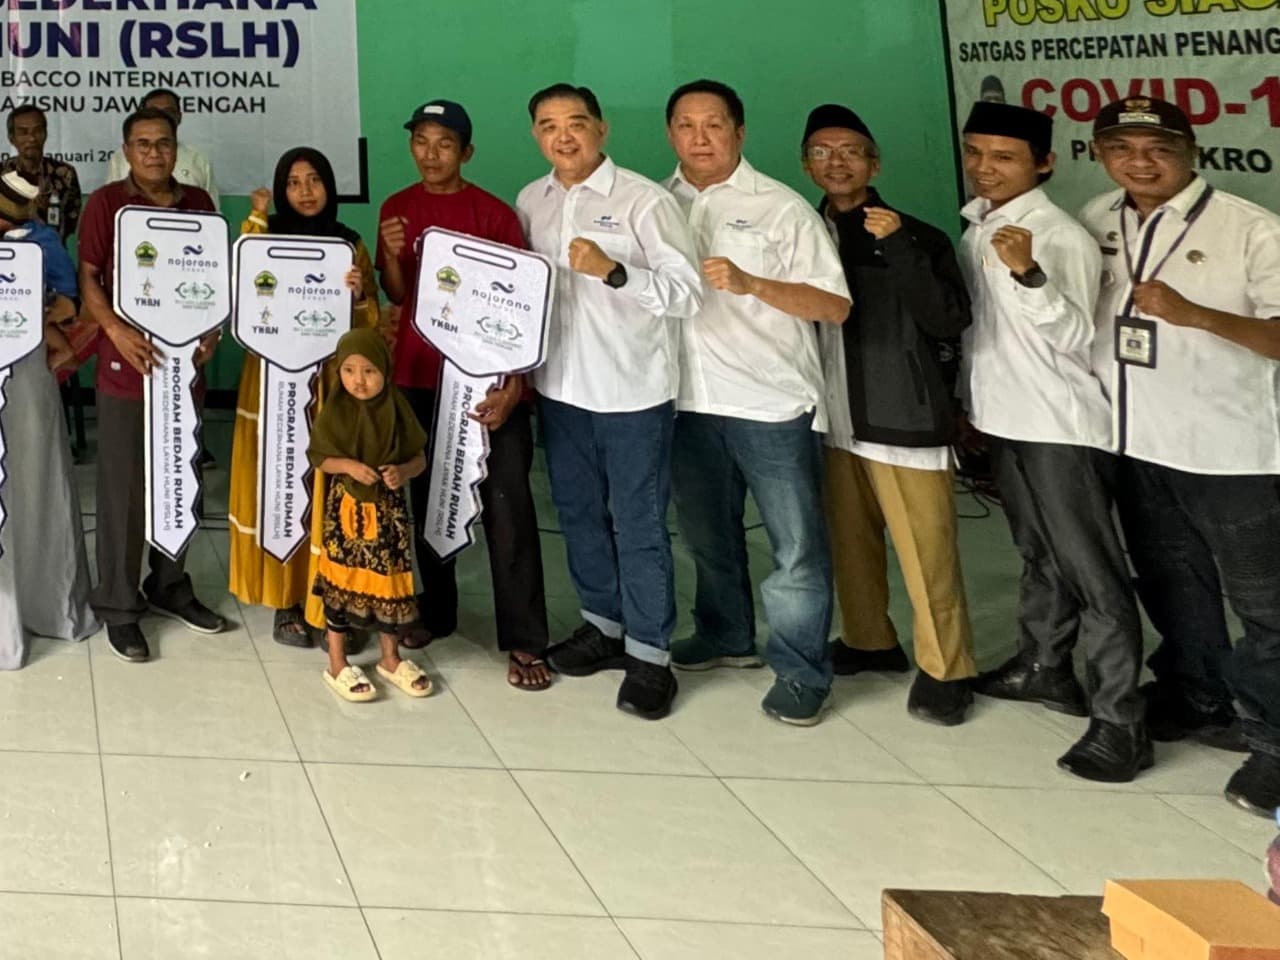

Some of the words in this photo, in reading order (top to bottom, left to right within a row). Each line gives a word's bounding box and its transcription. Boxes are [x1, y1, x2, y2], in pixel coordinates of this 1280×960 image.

[120, 19, 300, 68] (RSLH)
[959, 40, 1026, 63] SATGAS
[1032, 33, 1168, 61] PERCEPATAN
[1175, 27, 1280, 57] PENANG
[88, 70, 280, 88] INTERNATIONAL
[92, 96, 144, 113] JAW
[182, 96, 266, 113] ENGAH
[44, 149, 94, 162] anuari
[1198, 146, 1273, 173] KRO
[167, 257, 219, 268] nojorono
[288, 285, 341, 296] nojorono
[471, 288, 532, 312] nojorono
[172, 357, 181, 423] PROGRAM
[286, 382, 296, 443] PROGRAM
[173, 427, 182, 473] BEDAH
[285, 447, 295, 489] BEDAH
[452, 448, 464, 492] BEDAH
[174, 478, 183, 529] RUMAH
[284, 493, 294, 537] RUMAH
[446, 494, 460, 540] RUMAH
